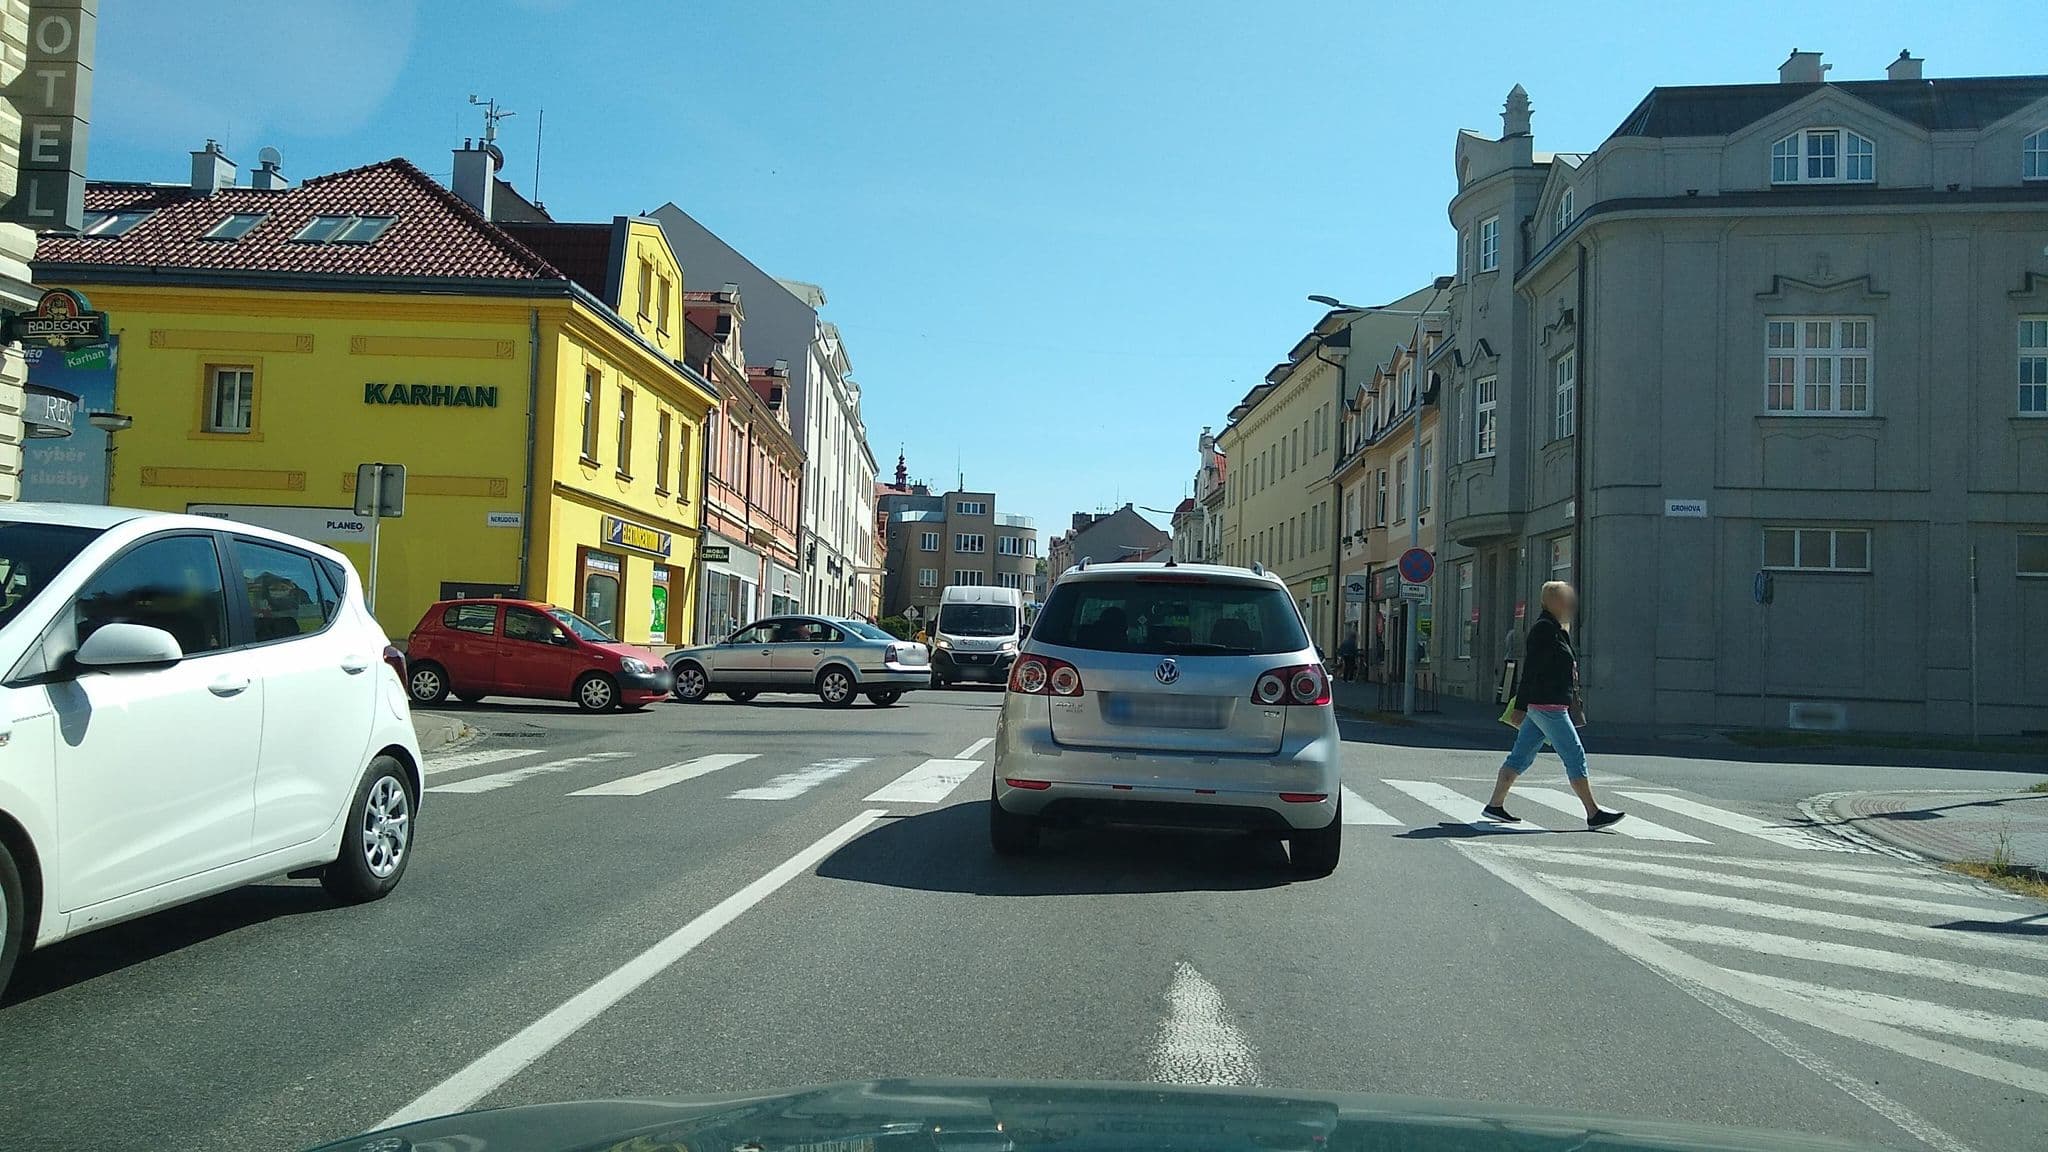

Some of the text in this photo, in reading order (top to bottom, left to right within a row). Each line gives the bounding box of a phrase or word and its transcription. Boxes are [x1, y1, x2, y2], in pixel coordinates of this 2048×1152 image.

[28, 320, 94, 335] RADEGAST
[67, 350, 105, 368] Karhan
[364, 383, 498, 408] KARHAN
[33, 446, 87, 465] výběr
[31, 470, 89, 488] služby
[1671, 504, 1701, 512] GROHOVA
[326, 521, 364, 531] PLANEO
